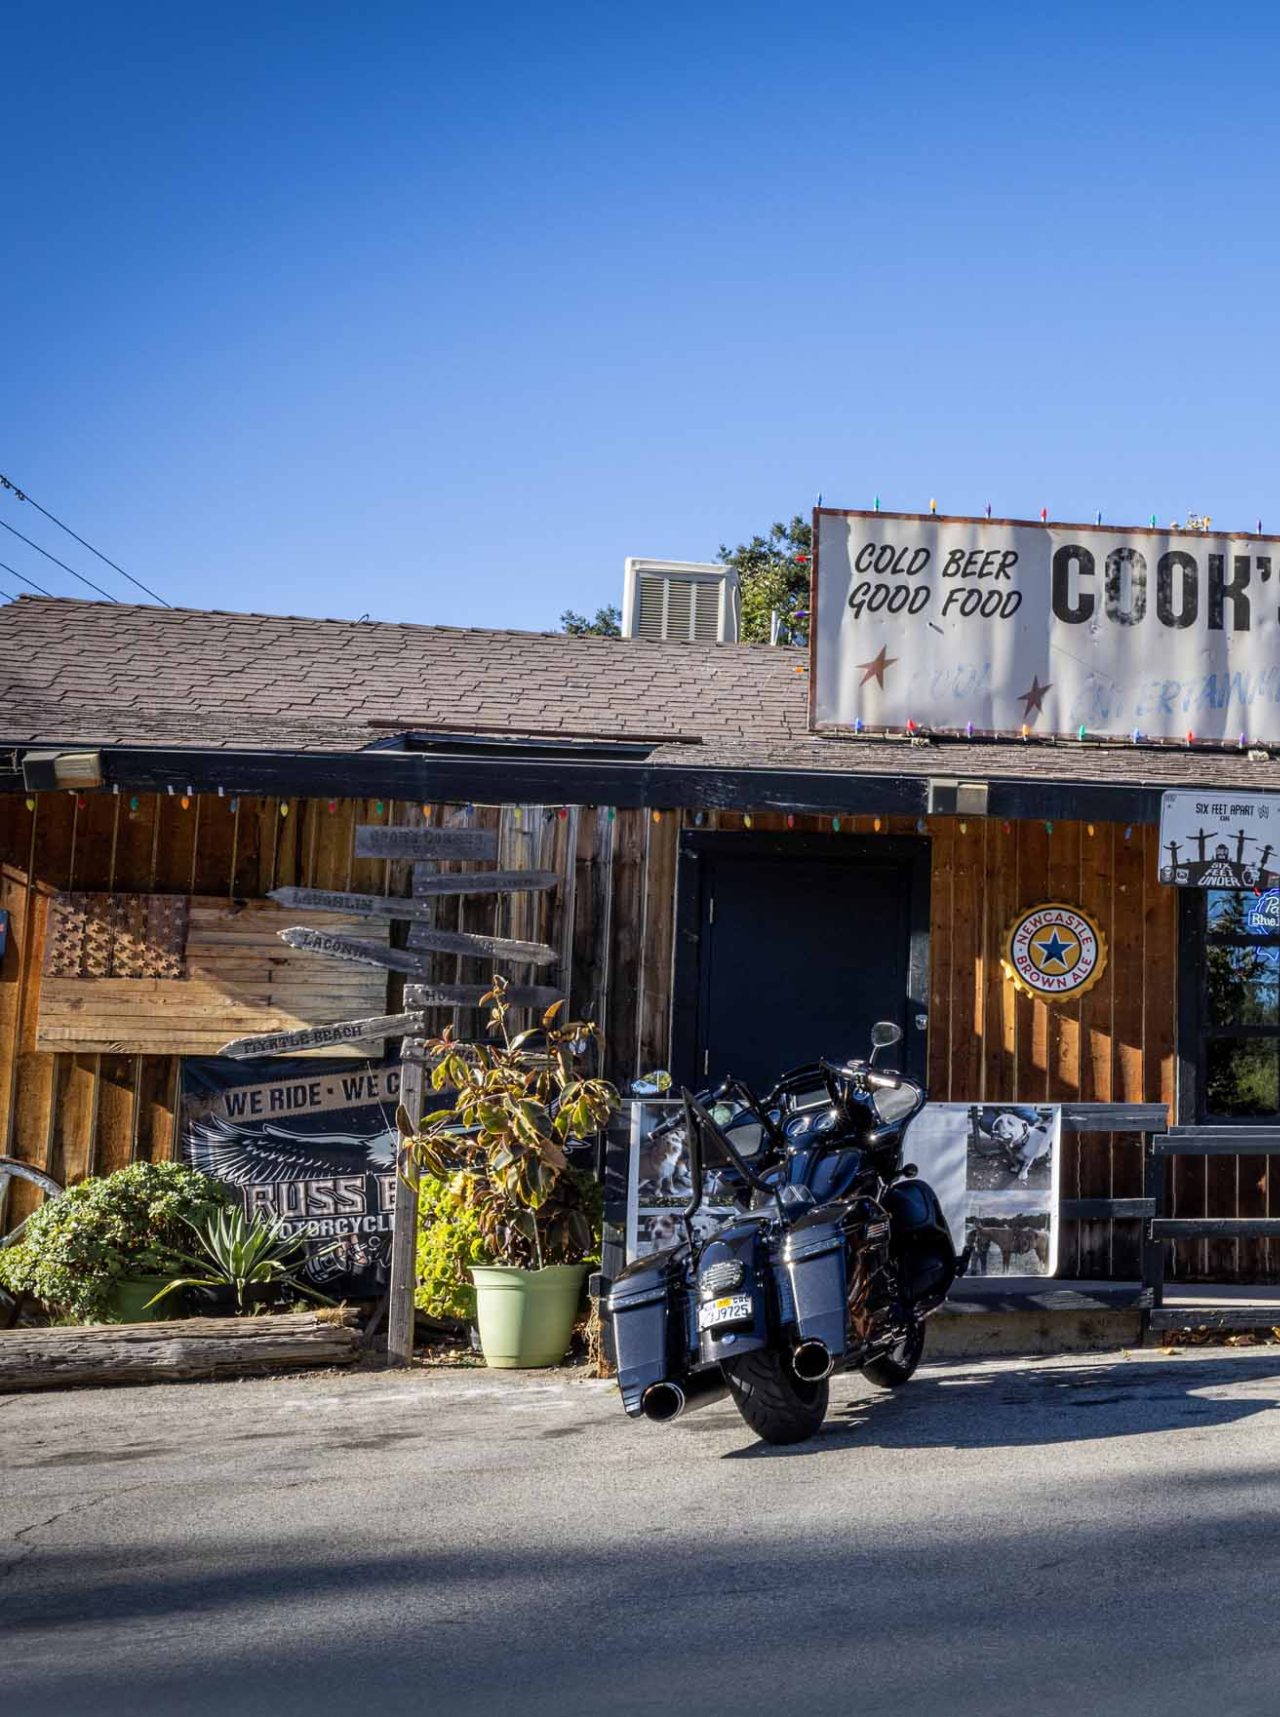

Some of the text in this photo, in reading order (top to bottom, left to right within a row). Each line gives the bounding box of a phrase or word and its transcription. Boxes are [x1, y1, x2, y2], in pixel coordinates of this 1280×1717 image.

[853, 541, 1020, 581] COLD BEER
[847, 582, 1023, 619] GOOD FOOD
[1195, 803, 1209, 815] SIX
[1211, 803, 1228, 815] FEET
[1230, 804, 1255, 816] APART
[1197, 876, 1241, 887] UNDER
[1205, 868, 1234, 877] FEET
[1017, 912, 1092, 946] NEWCASTLE
[1017, 955, 1091, 988] BROWN ALE
[313, 1025, 362, 1043] BEACH
[223, 1090, 263, 1117] WE
[269, 1083, 322, 1111] RIDE
[340, 1074, 379, 1101] WE
[242, 1173, 366, 1224] RUSS
